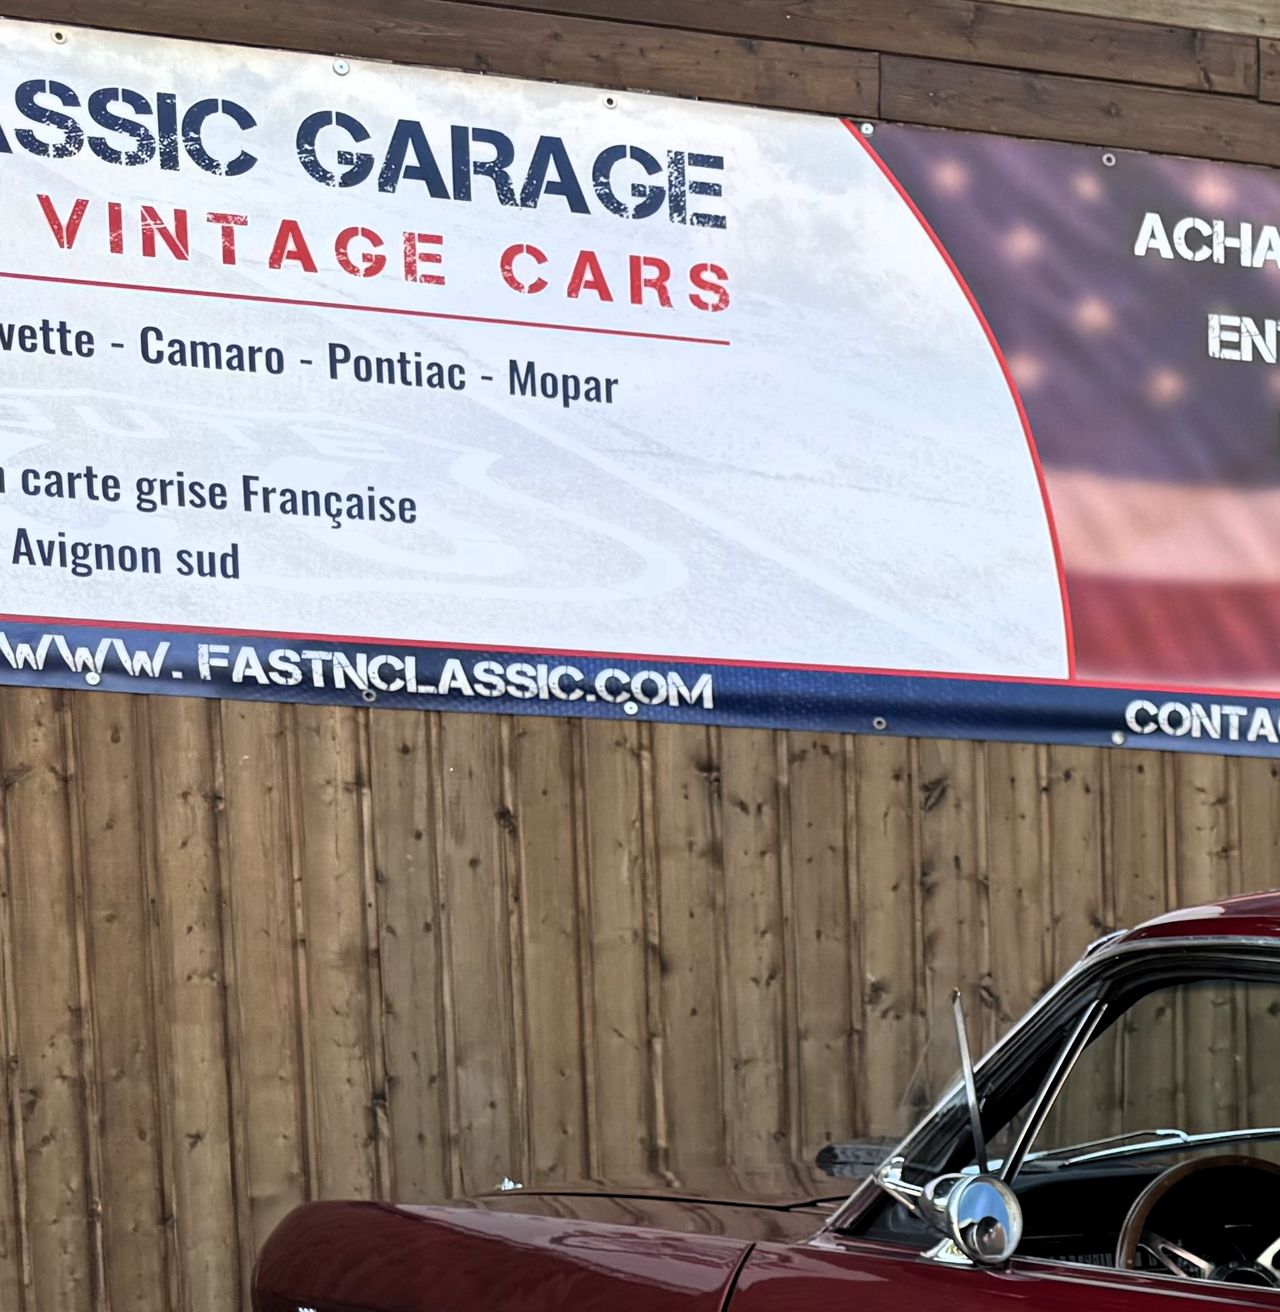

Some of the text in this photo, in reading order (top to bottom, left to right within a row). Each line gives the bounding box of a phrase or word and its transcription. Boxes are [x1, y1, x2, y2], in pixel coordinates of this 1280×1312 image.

[0, 79, 728, 229] SSIC GARAGE
[37, 193, 731, 313] VINTAGE CARS
[140, 326, 285, 375] Camaro
[328, 342, 467, 392] Pontiac
[508, 359, 619, 407] Mopar
[21, 466, 121, 502] carte
[136, 471, 228, 513] grise
[242, 475, 417, 529] Française
[12, 528, 240, 579] Avignon sud
